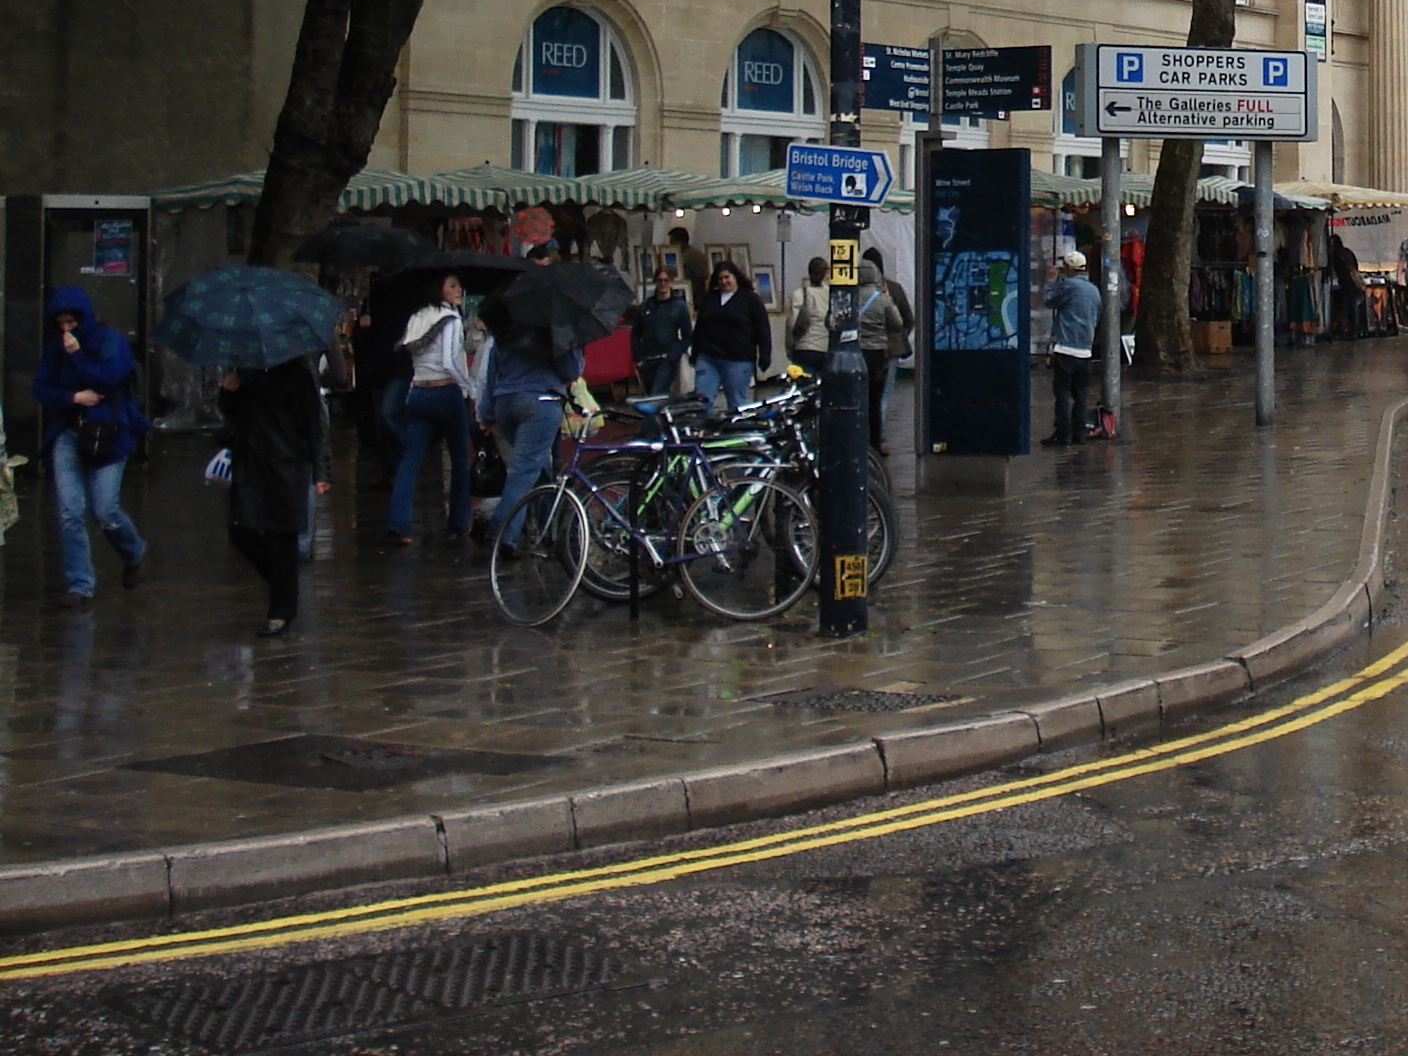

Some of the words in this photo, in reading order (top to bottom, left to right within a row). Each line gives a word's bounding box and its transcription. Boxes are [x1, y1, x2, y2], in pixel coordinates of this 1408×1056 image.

[543, 42, 587, 68] REED
[1161, 53, 1246, 70] SHOPPERS
[744, 61, 783, 84] REED
[1122, 55, 1139, 80] P
[1268, 61, 1284, 84] P
[1159, 71, 1191, 85] CAR
[1199, 72, 1248, 87] PARKS
[1137, 96, 1162, 110] The
[1169, 97, 1232, 112] Galleries
[1237, 99, 1274, 113] FULL
[1137, 111, 1216, 126] Alternative
[1222, 114, 1275, 130] parking
[792, 151, 829, 166] Bristol
[832, 154, 868, 172] Bridge
[791, 171, 815, 182] Castle
[815, 185, 834, 195] Back
